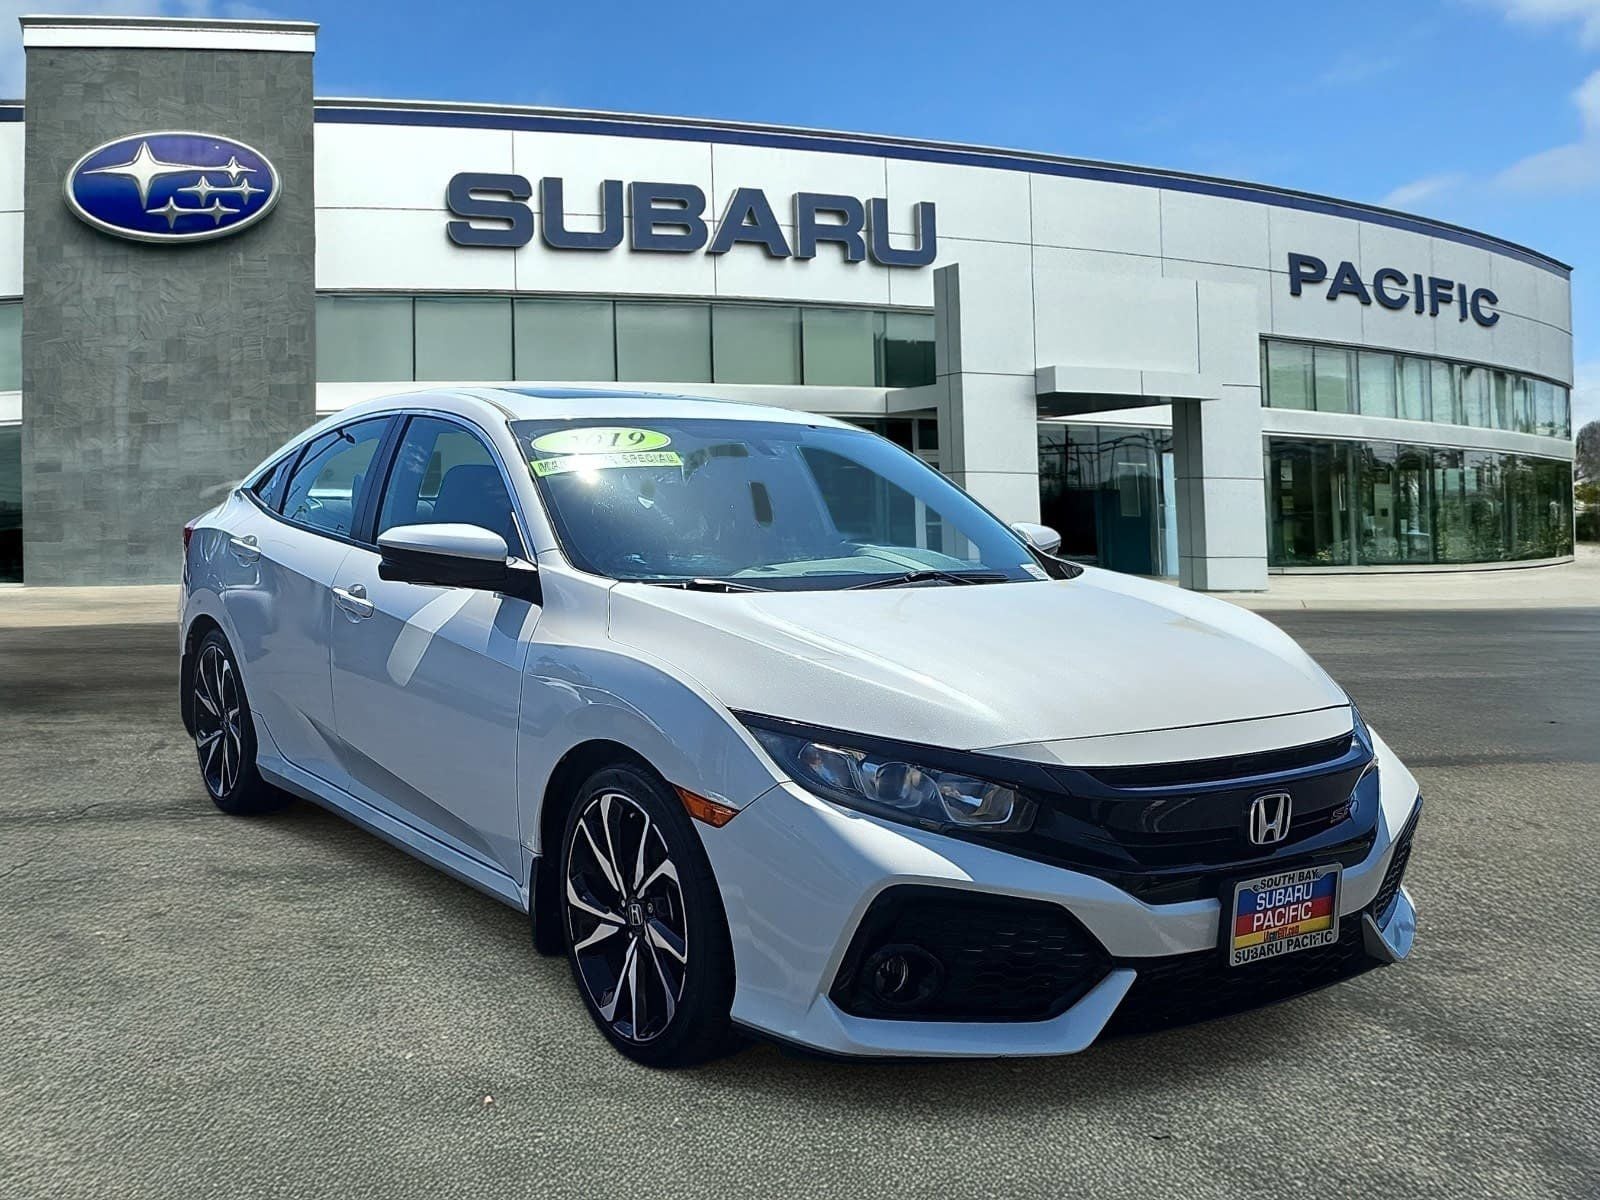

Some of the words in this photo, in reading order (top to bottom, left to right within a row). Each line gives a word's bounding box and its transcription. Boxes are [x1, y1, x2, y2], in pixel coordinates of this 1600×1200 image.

[446, 172, 937, 267] SUBARU
[1288, 252, 1500, 327] PACIFIC
[1260, 874, 1296, 890] SOUTH
[1298, 869, 1319, 881] BAY
[1256, 883, 1313, 911] SUBARU
[1253, 901, 1312, 931] PACIFIC
[1234, 940, 1283, 964] SUBARU
[1286, 931, 1333, 952] PACIFIC
